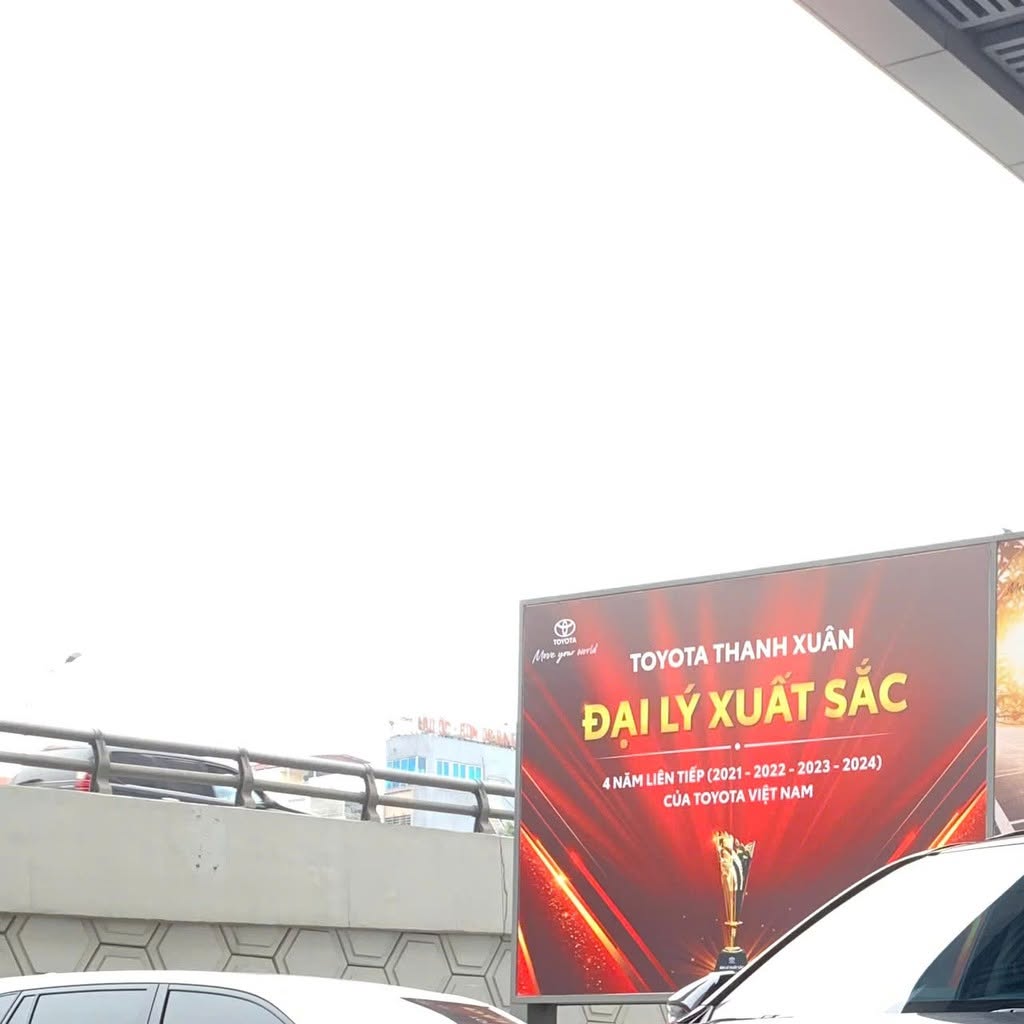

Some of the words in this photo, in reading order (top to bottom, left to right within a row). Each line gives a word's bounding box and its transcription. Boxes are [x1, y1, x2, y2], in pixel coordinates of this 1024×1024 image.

[553, 637, 577, 645] TOYOTA
[630, 646, 708, 672] TOYOTA
[713, 636, 787, 663] THANH
[792, 625, 854, 655] XUÂN
[582, 698, 649, 749] ĐẠI
[660, 683, 701, 733] LÝ
[708, 672, 815, 729] XUẤT
[824, 657, 909, 719] SẮC
[602, 777, 611, 790] 4
[613, 772, 643, 789] NĂM
[646, 769, 674, 786] LIÊN
[677, 766, 705, 783] TIẾP
[707, 766, 742, 783] (2021
[754, 763, 786, 778] 2022
[797, 759, 830, 775] 2023
[842, 755, 882, 771] 2024)
[663, 790, 691, 807] CỦA
[694, 790, 746, 805] TOYOTA
[748, 785, 778, 805] VIỆT
[780, 784, 814, 800] NAM
